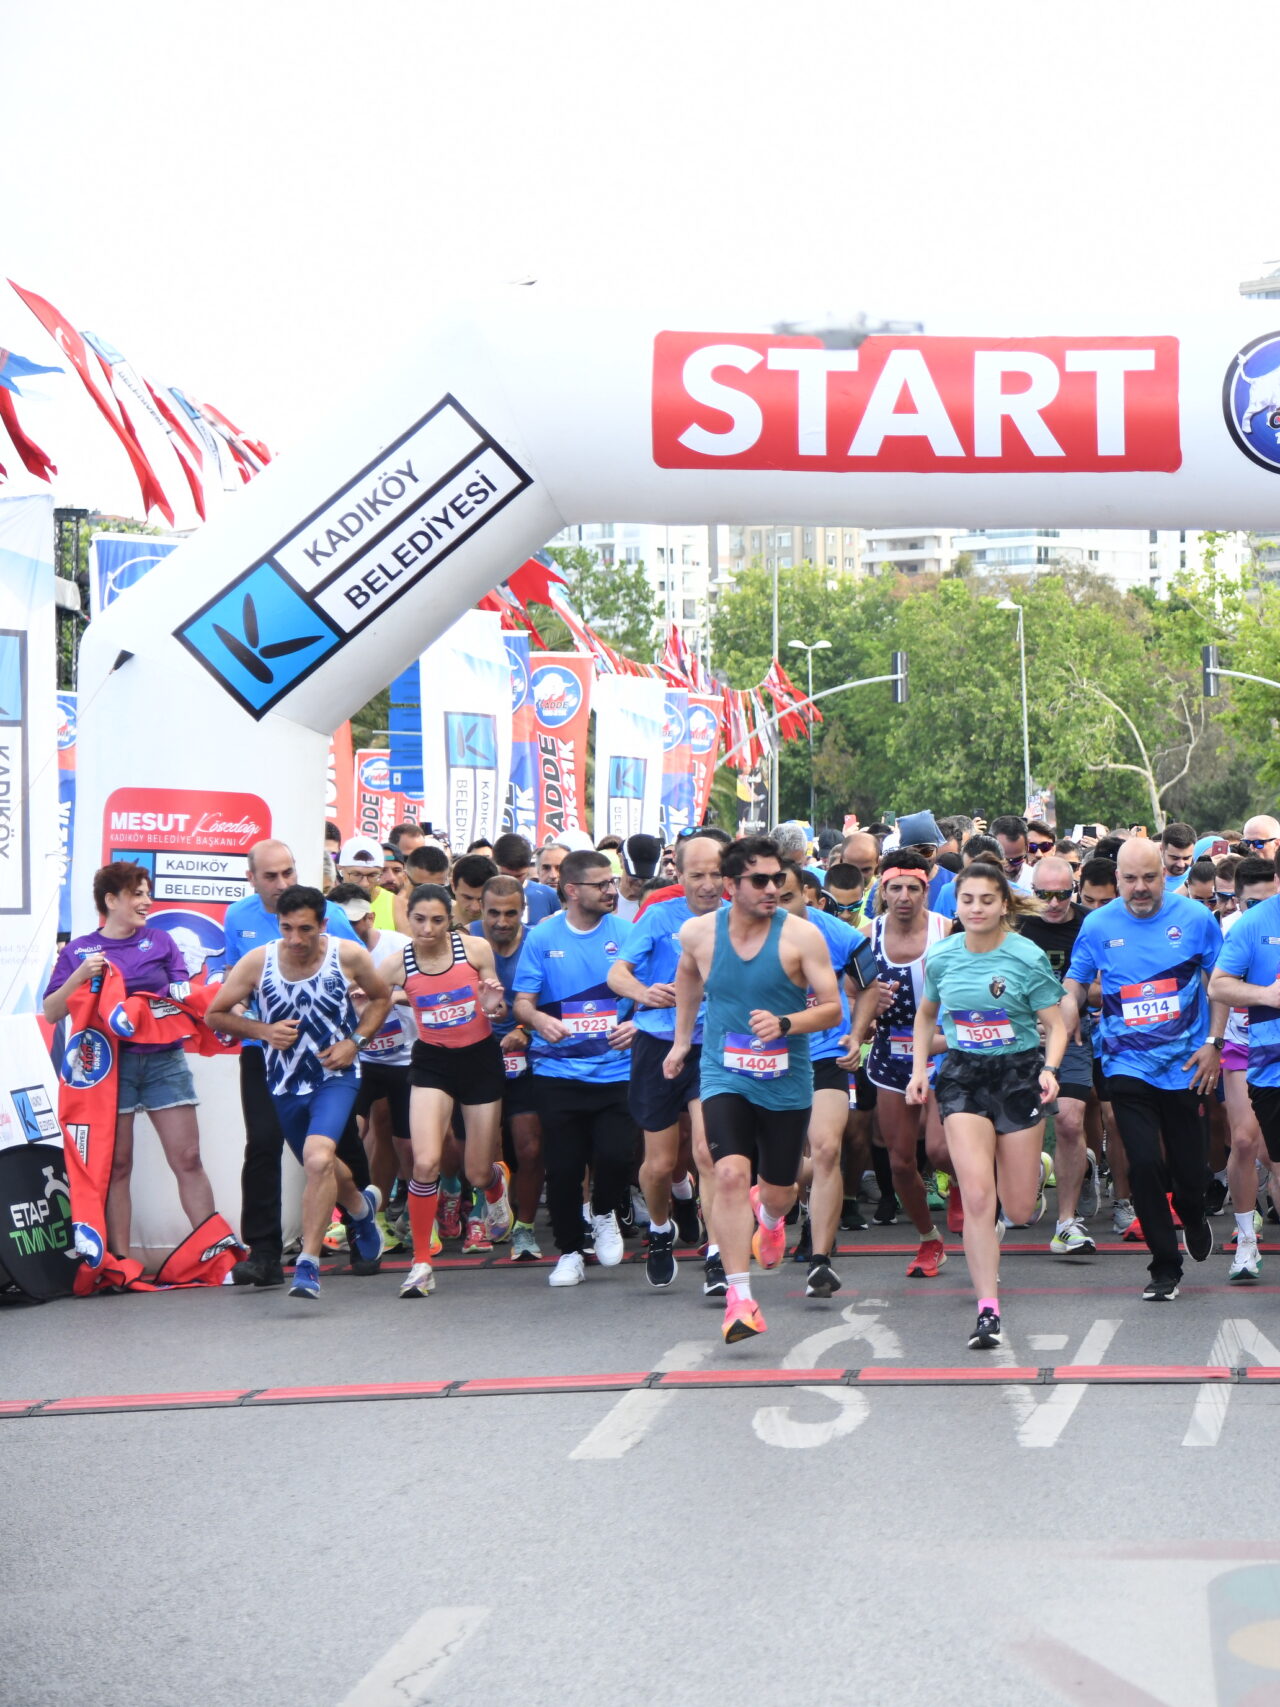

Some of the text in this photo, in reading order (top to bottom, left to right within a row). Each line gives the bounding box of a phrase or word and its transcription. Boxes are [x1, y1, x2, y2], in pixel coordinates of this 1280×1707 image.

[678, 344, 1155, 457] START
[303, 459, 420, 567] KADIKÖY
[344, 469, 498, 610] BELEDİYESİ
[558, 739, 579, 832] 0K-21K
[455, 779, 469, 853] BELEDİYE
[480, 781, 490, 837] KADIKÖ
[111, 812, 191, 832] MESUT
[110, 833, 237, 847] KADIKÖY BELEDİYE BAŞKANI
[166, 858, 228, 872] KADIKÖY
[164, 883, 246, 898] BELEDİYESİ
[431, 1006, 467, 1023] 1023
[1132, 1000, 1170, 1017] 1914
[572, 1018, 608, 1032] 1923
[965, 1027, 1001, 1042] 1501
[736, 1056, 777, 1070] 1404
[10, 1199, 50, 1228] ETAP
[9, 1220, 67, 1256] TIMING
